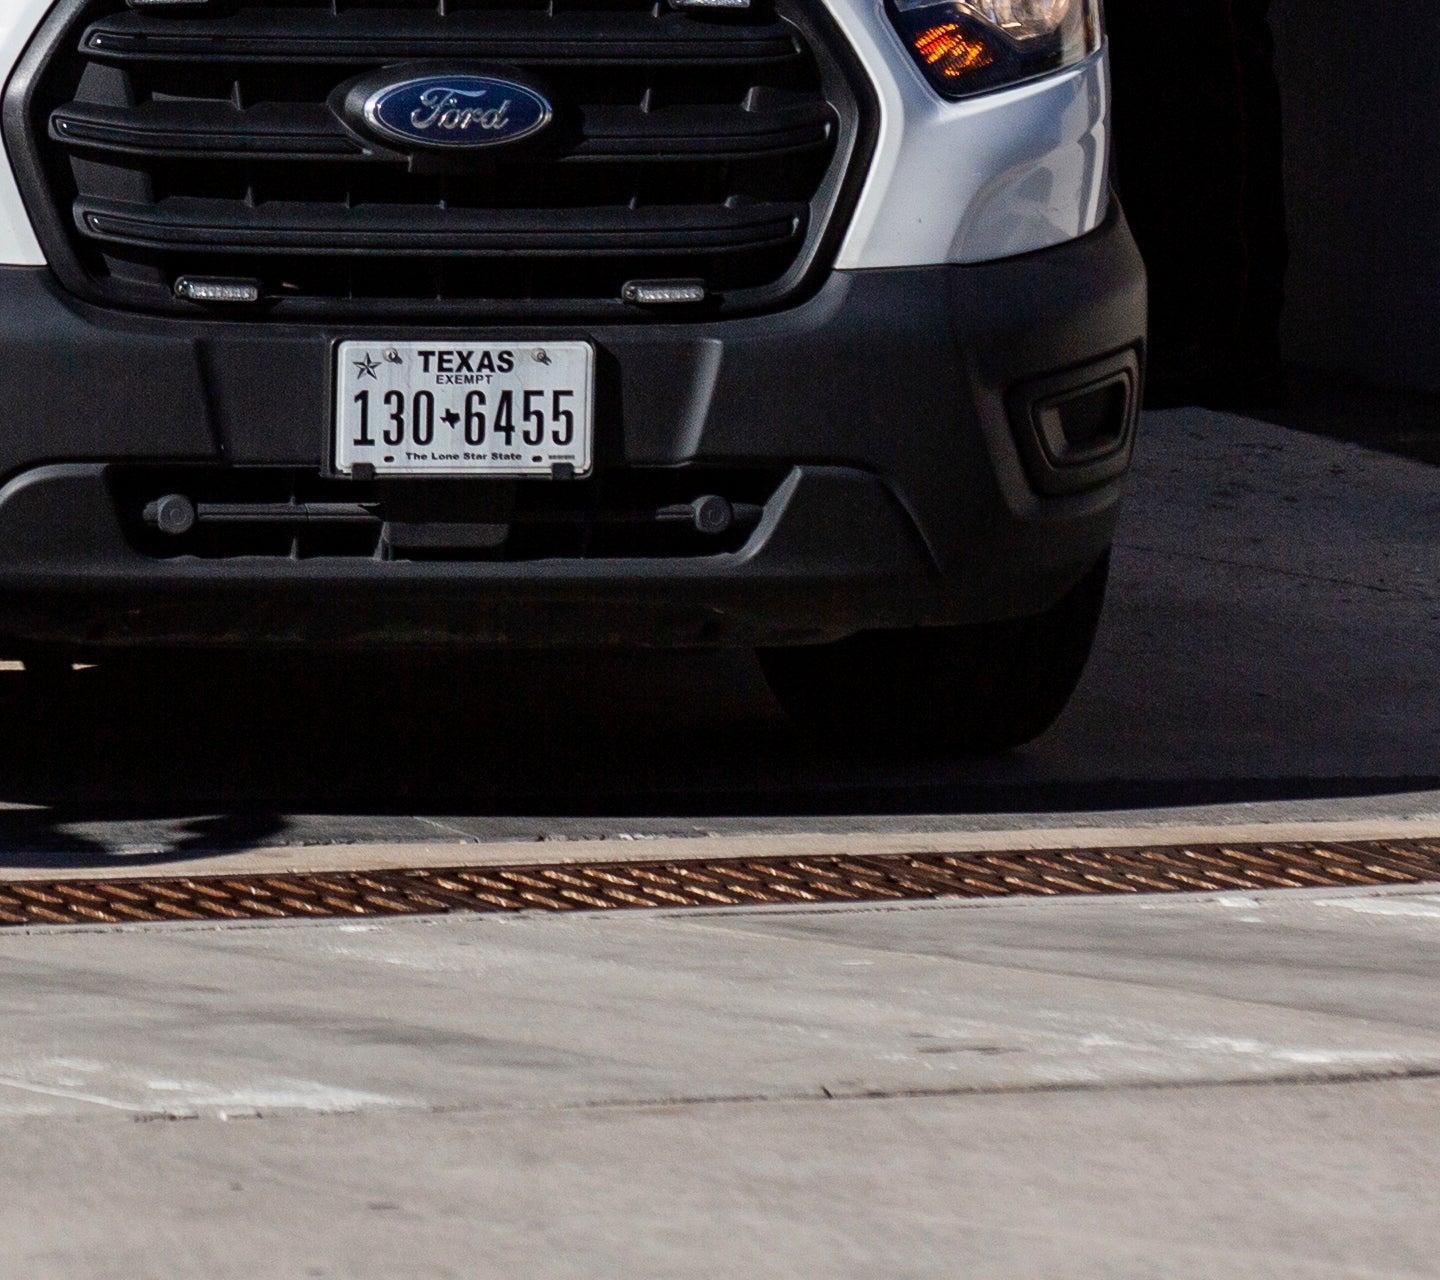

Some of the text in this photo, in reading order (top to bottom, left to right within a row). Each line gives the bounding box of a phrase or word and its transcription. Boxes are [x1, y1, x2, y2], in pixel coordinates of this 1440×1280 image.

[410, 86, 512, 130] Ford
[417, 350, 515, 374] TEXAS
[435, 374, 494, 386] EXEMPT
[405, 451, 523, 461] The Lone Star State
